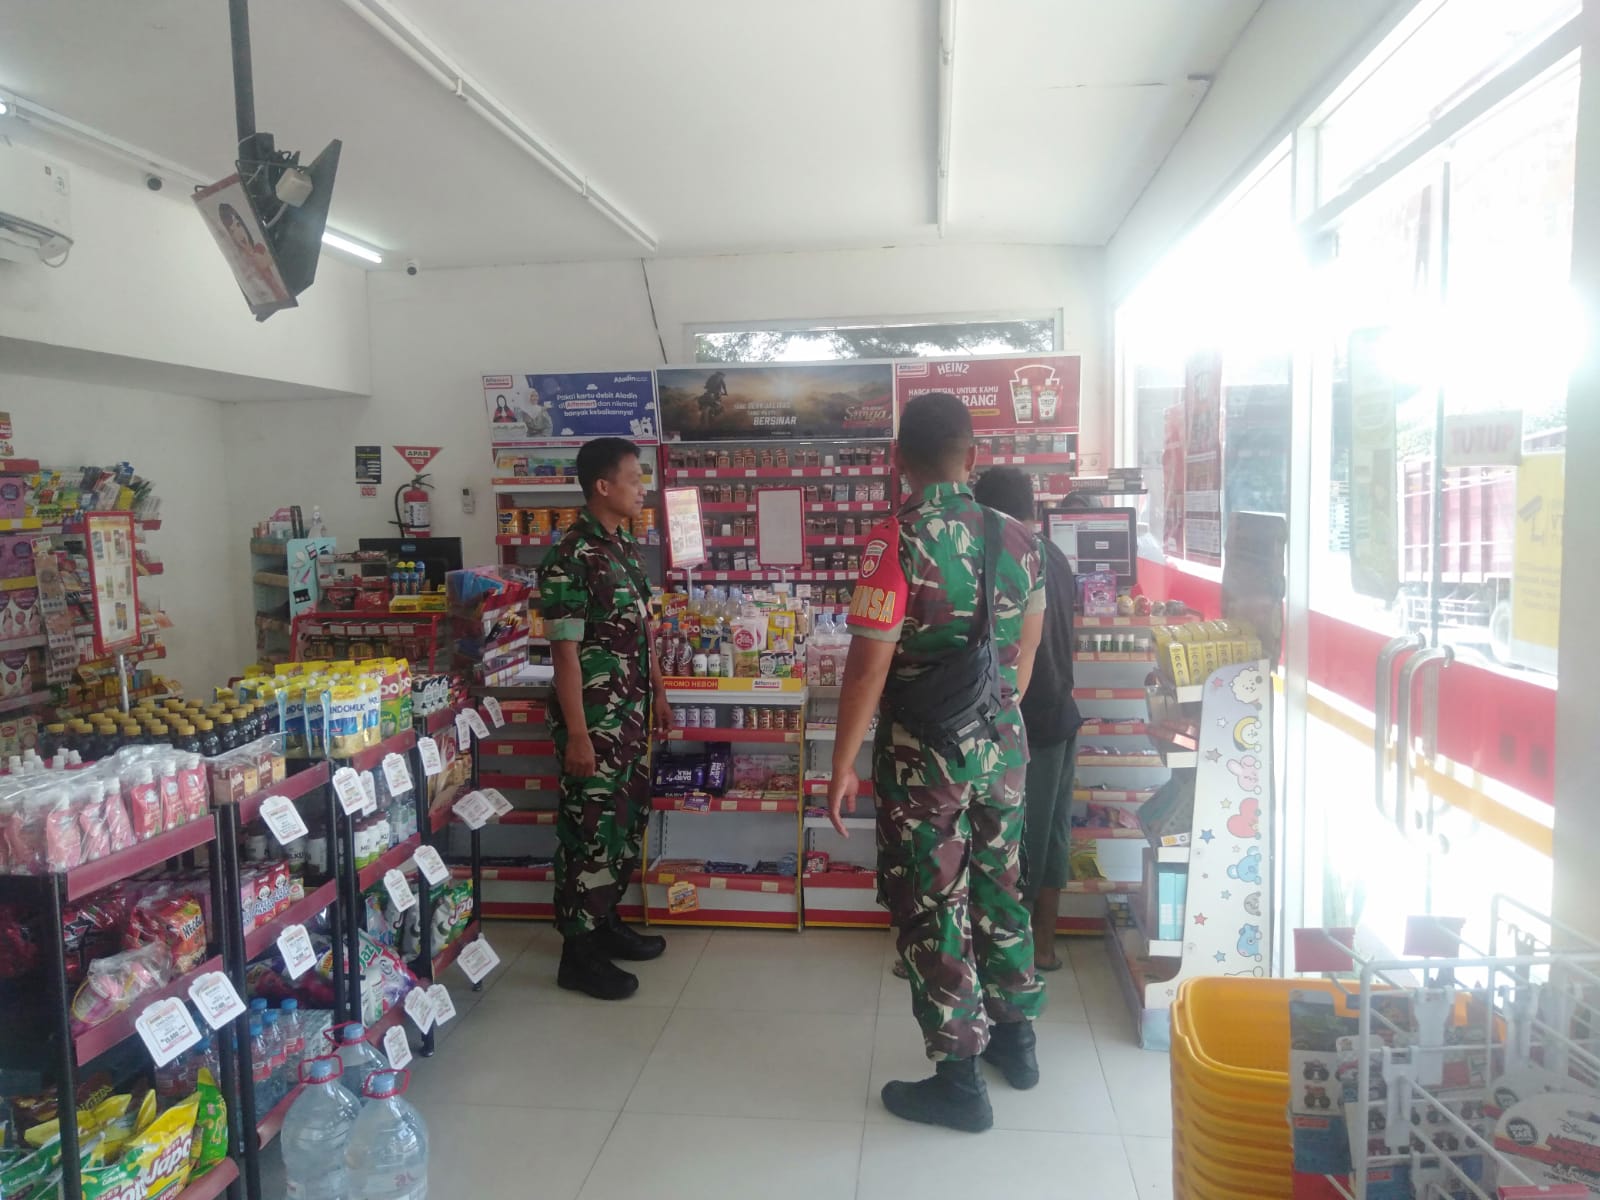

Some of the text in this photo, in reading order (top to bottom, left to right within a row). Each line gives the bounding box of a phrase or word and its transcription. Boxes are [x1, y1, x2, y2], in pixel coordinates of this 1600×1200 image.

[937, 362, 970, 376] HEINZ
[979, 385, 999, 394] KAMU
[576, 392, 595, 400] kartu
[595, 391, 614, 399] debit
[615, 392, 638, 400] Aladin
[597, 400, 611, 408] dan
[611, 399, 638, 408] nikmati
[564, 409, 589, 417] banyak
[753, 416, 797, 426] BERSINAR
[1450, 423, 1515, 455] TUTUP
[663, 680, 718, 688] PROMO HEBOH
[329, 703, 366, 713] INDOMILK
